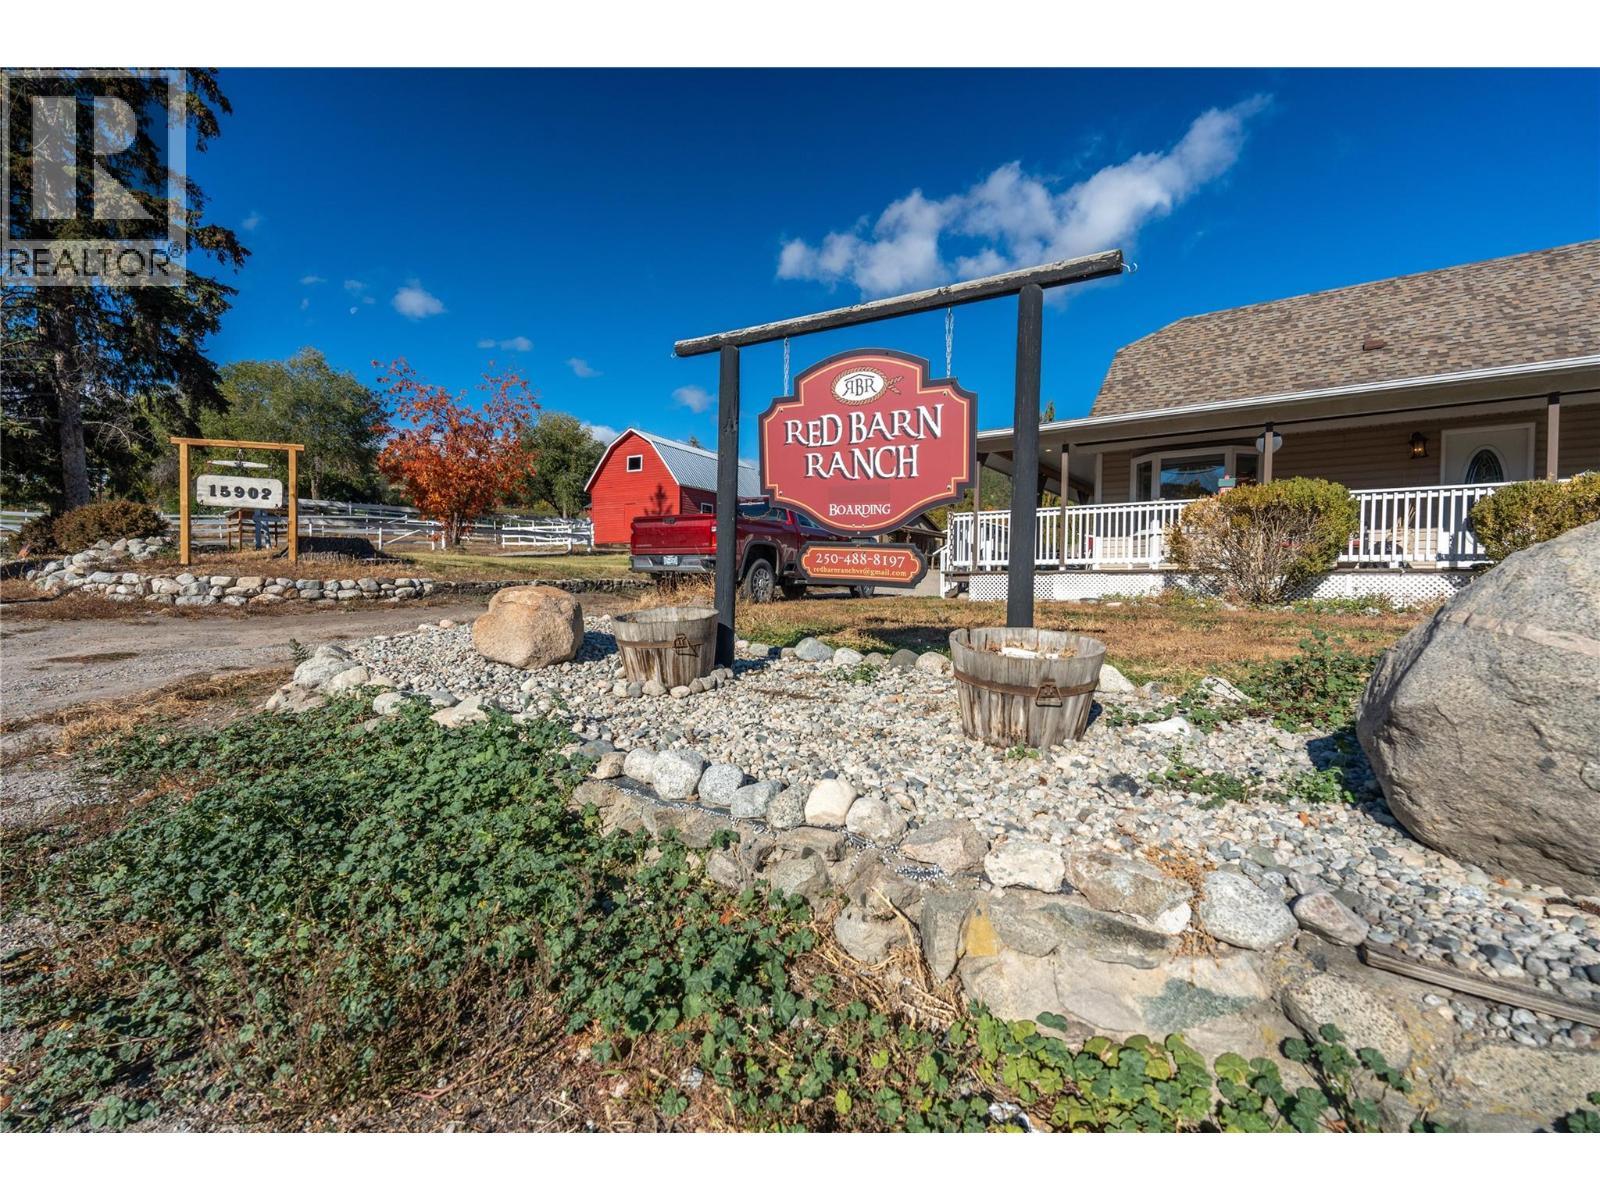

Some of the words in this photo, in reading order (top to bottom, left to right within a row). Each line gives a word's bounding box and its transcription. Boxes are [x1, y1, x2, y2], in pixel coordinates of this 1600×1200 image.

[785, 413, 843, 447] RED
[849, 403, 944, 445] BARN
[804, 444, 920, 480] RANCH
[208, 484, 272, 500] 15902
[815, 553, 905, 568] 250-488-8197
